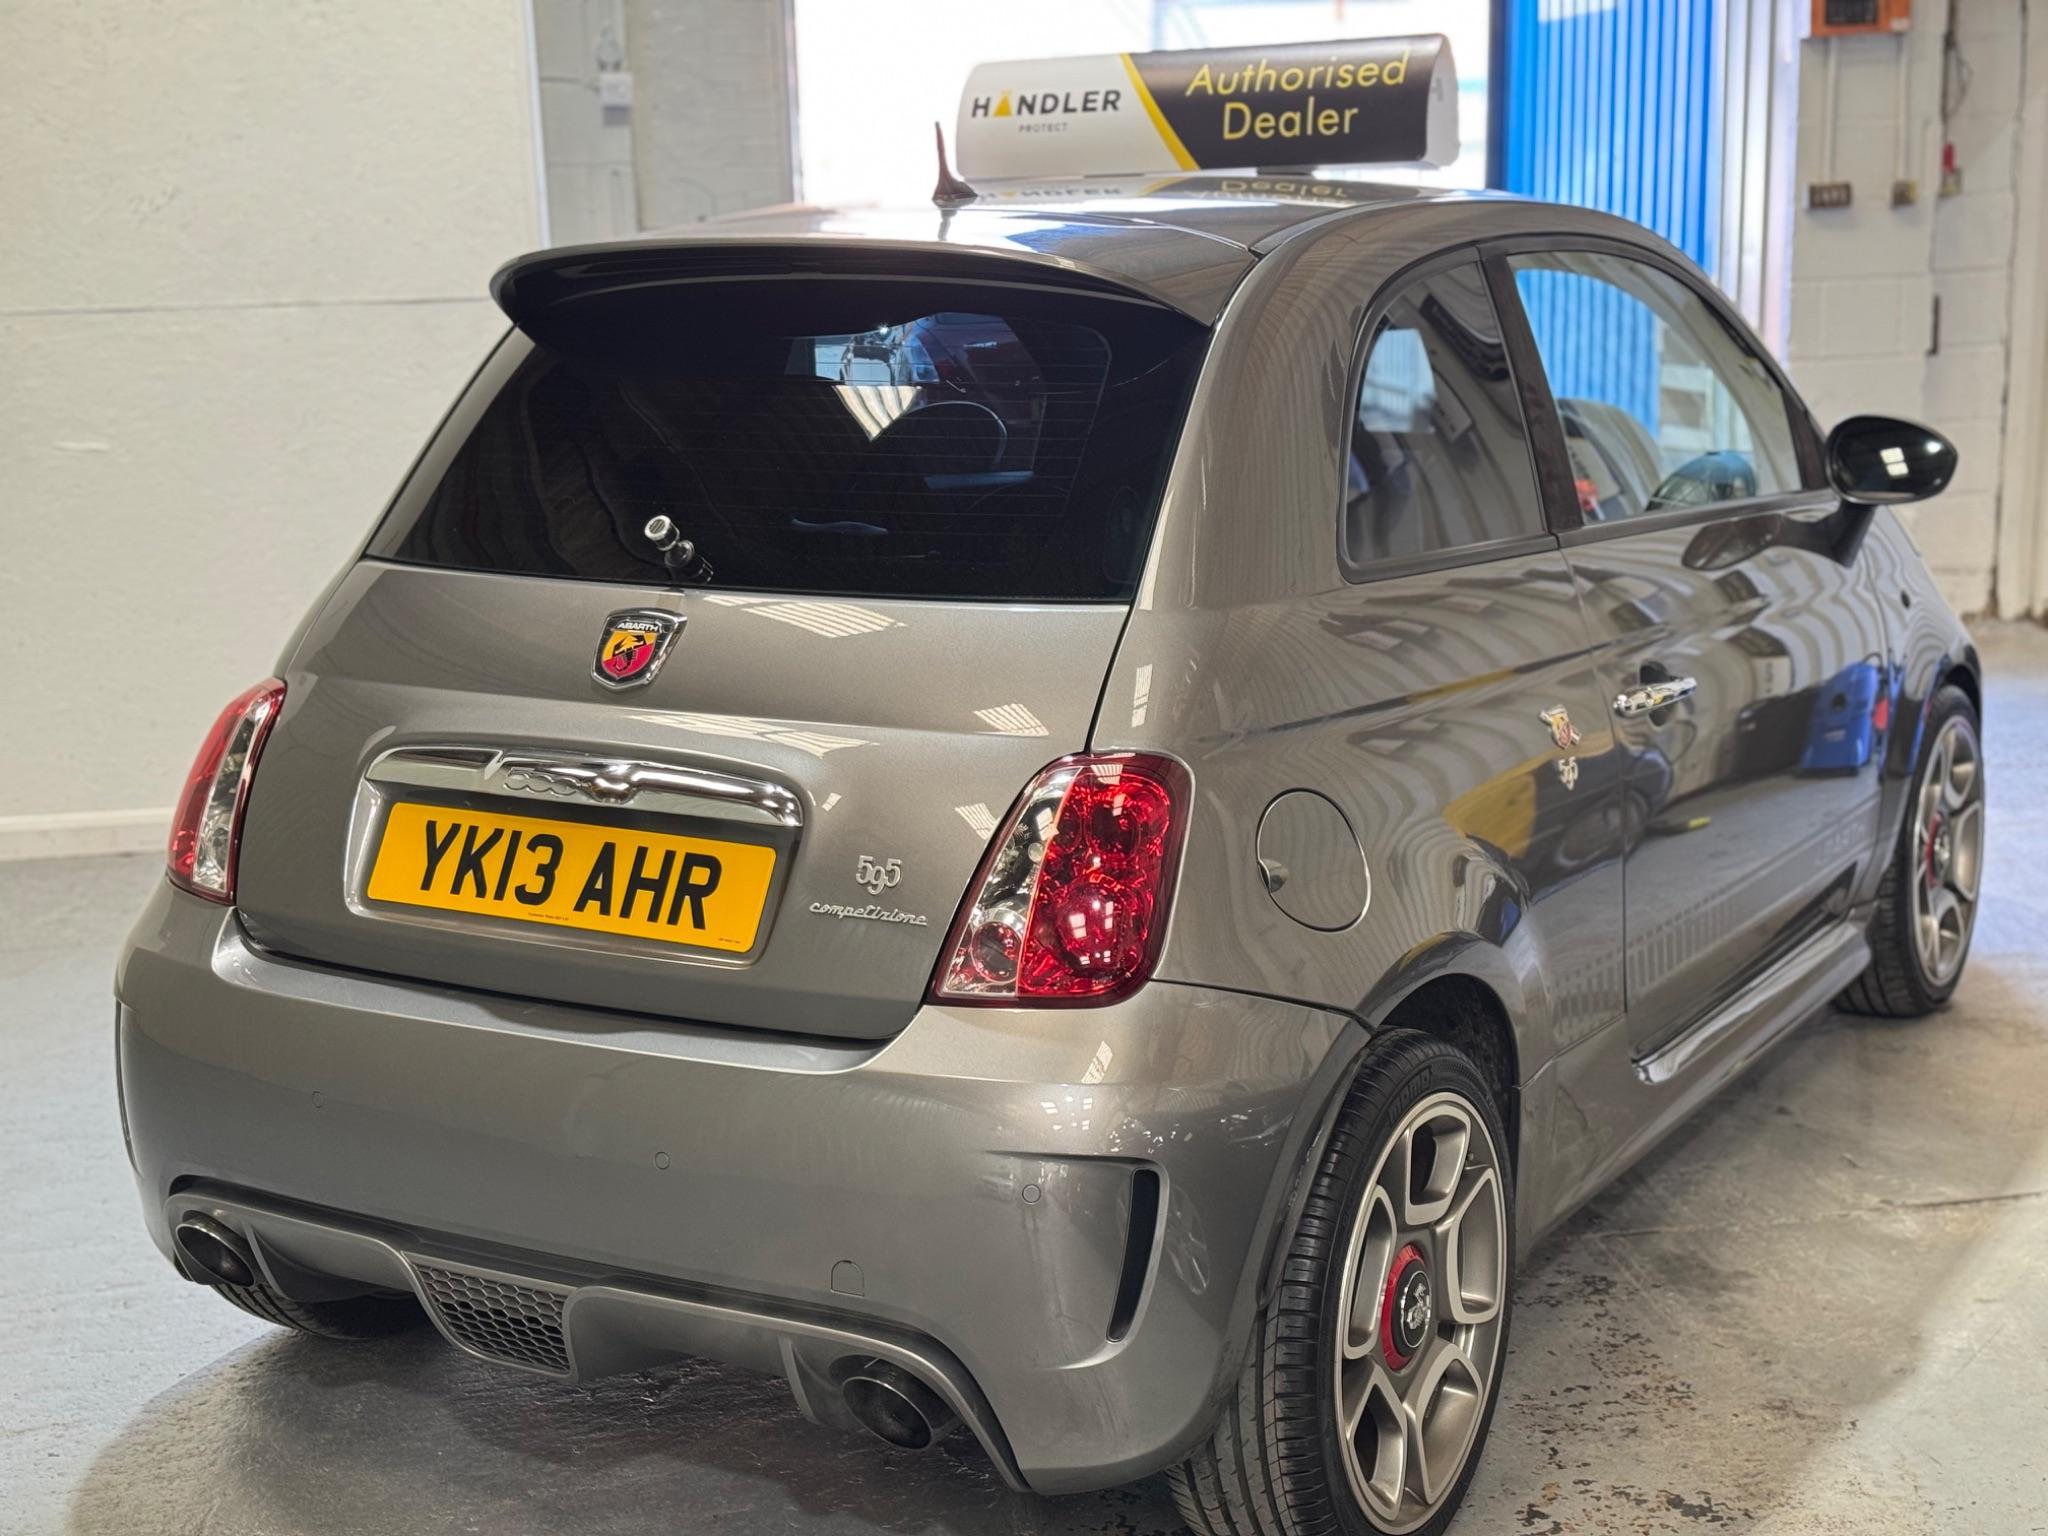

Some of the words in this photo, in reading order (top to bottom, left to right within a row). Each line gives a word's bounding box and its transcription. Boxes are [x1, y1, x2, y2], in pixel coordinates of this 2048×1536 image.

[1184, 50, 1410, 97] Authorised
[1018, 122, 1068, 133] PROTECT
[1223, 96, 1359, 140] Dealer
[617, 622, 659, 632] ABARTH
[420, 820, 564, 906] YK13
[572, 841, 722, 930] AHR
[855, 855, 903, 895] 595
[808, 902, 928, 926] competizione
